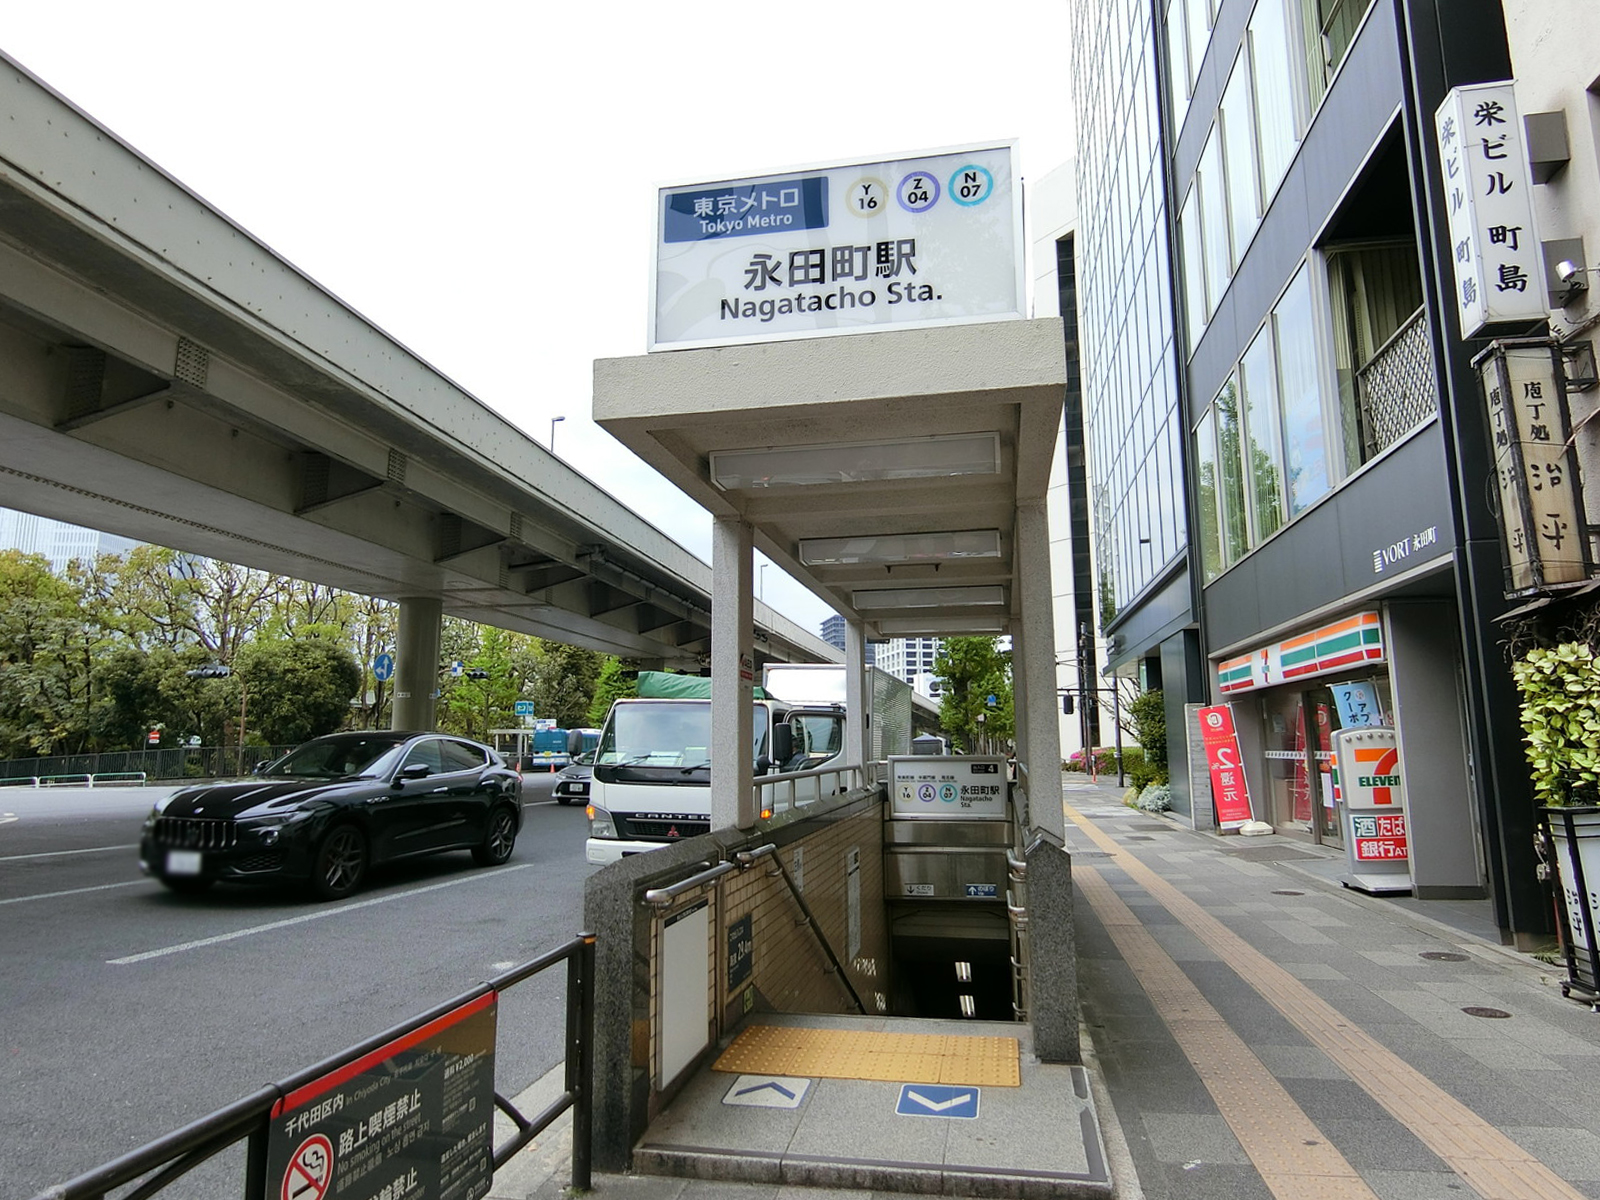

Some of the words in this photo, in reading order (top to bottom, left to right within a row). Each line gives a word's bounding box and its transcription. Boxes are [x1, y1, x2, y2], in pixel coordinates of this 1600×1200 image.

[913, 178, 922, 189] Z
[964, 171, 977, 183] N
[862, 184, 871, 196] Y
[907, 190, 929, 204] 04
[960, 184, 981, 198] 07
[693, 187, 799, 218] 東京メトロ
[858, 196, 877, 210] 16
[700, 216, 743, 234] Tokyo
[747, 212, 793, 229] Metro
[743, 238, 917, 291] 永田町駅
[720, 285, 876, 322] Nagatacho
[887, 281, 942, 304] Sta.
[1382, 537, 1411, 565] VORT
[988, 764, 995, 773] 4
[960, 785, 1000, 795] 永田町駅
[1355, 818, 1377, 837] 酒
[284, 1093, 344, 1138] 千代田区内
[338, 1088, 421, 1157] 路上喫煙禁止
[337, 1160, 349, 1175] No
[350, 1139, 380, 1168] smoking
[381, 1134, 391, 1146] on
[369, 1166, 418, 1200] 輪禁止
